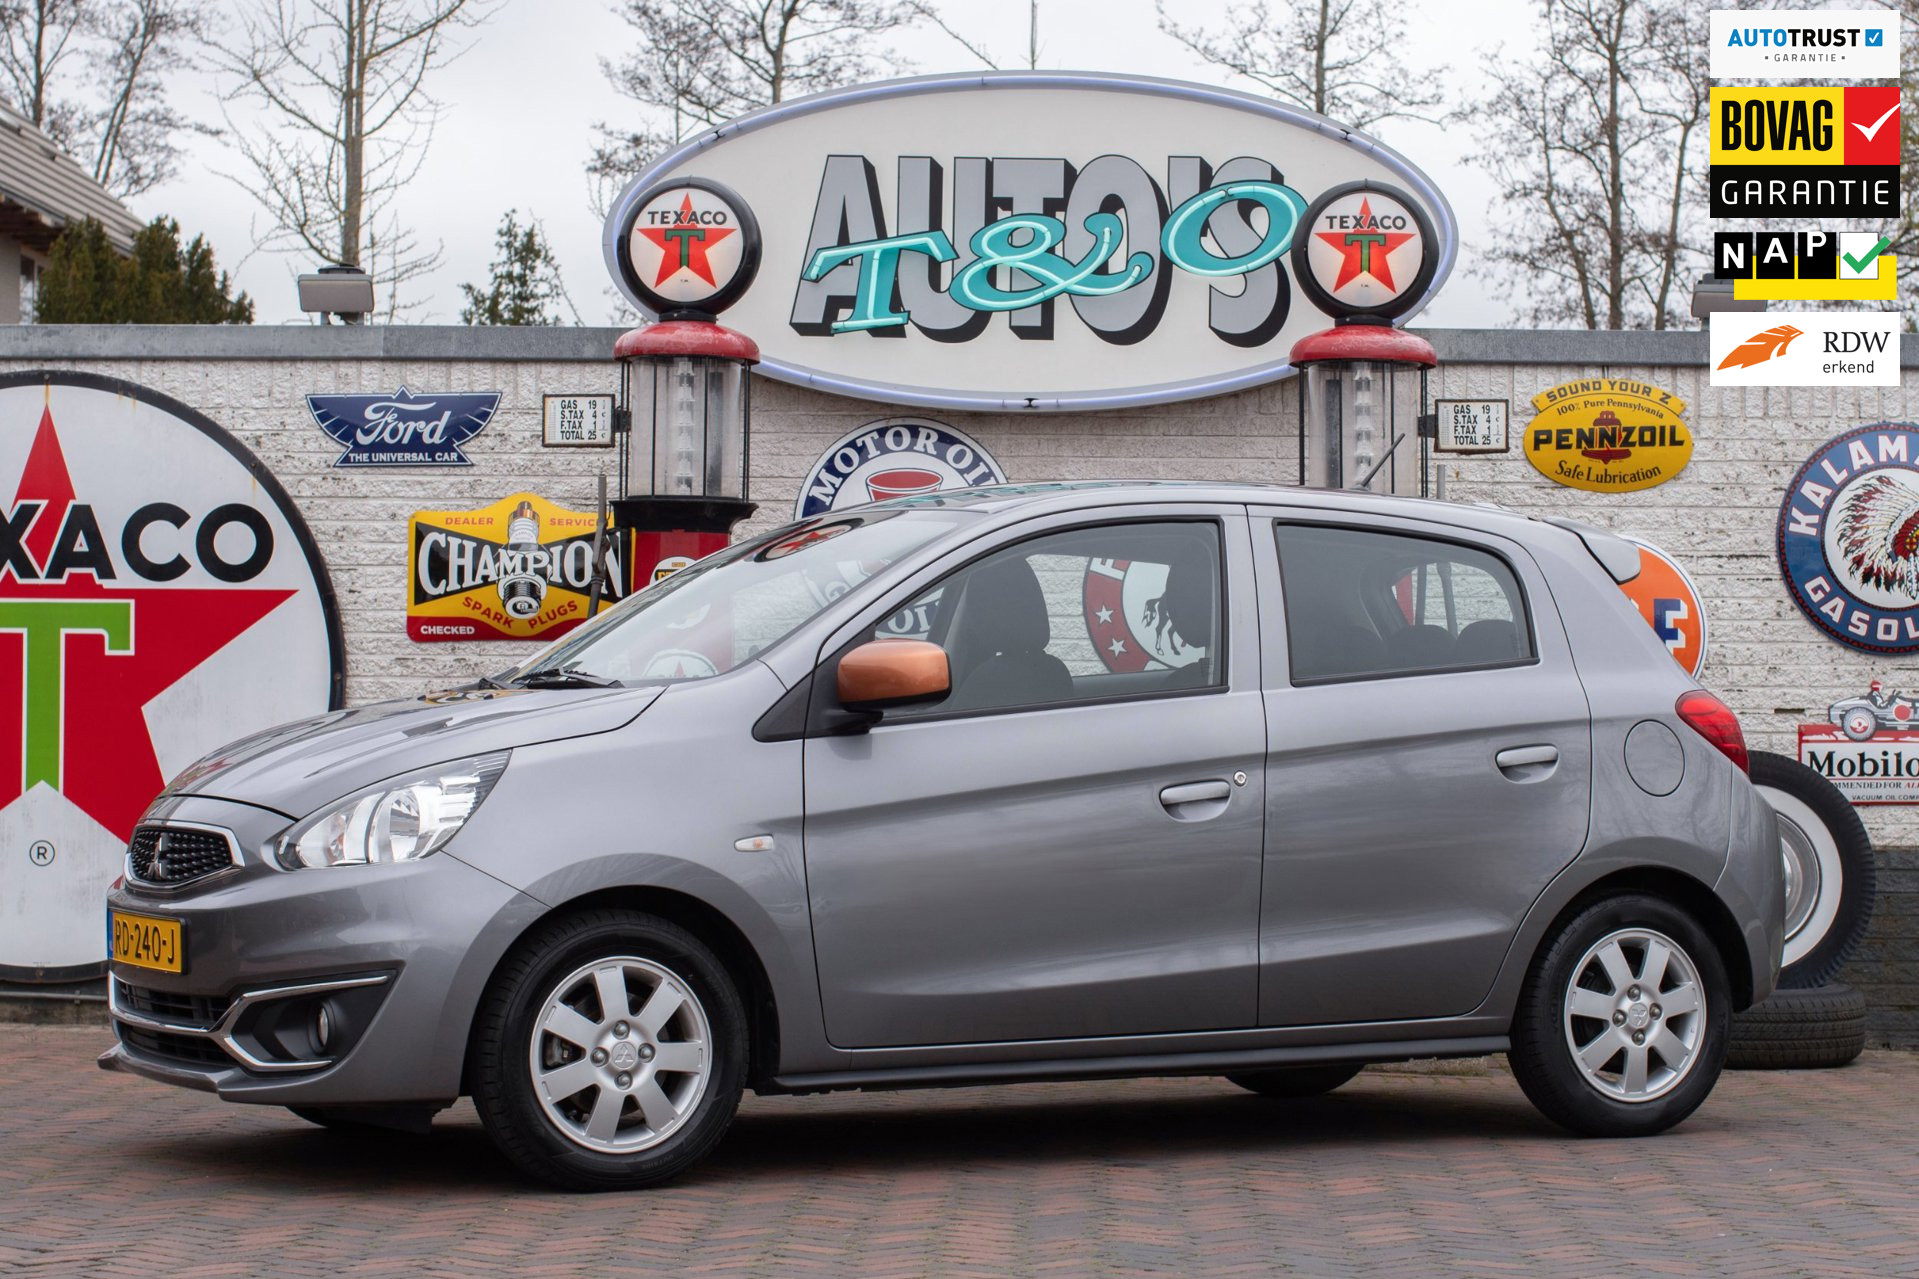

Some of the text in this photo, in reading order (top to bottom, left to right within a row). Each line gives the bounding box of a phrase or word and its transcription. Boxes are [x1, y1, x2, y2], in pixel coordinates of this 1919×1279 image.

[647, 210, 728, 226] TEXACO
[1325, 215, 1407, 230] TEXACO
[789, 154, 1291, 346] AUTO'S
[1547, 380, 1672, 405] SOUND YOUR Z
[560, 399, 578, 410] GAS
[588, 399, 597, 410] 19
[1453, 404, 1471, 415] GAS
[1481, 404, 1491, 415] 19
[1584, 400, 1605, 409] Pure
[1607, 399, 1665, 420] Pennsylvania
[560, 410, 585, 420] S.TAX
[592, 410, 597, 420] 4
[1453, 414, 1478, 425] S.TAX
[1486, 414, 1491, 425] 4
[355, 401, 452, 446] Ford
[560, 420, 583, 430] F.TAX
[593, 420, 597, 431] 1
[1453, 425, 1477, 435] F.TAX
[1487, 425, 1491, 435] 1
[560, 430, 585, 440] TOTAL
[588, 430, 597, 440] 25
[1453, 435, 1479, 446] TOTAL
[1481, 435, 1491, 446] 25
[1533, 424, 1686, 452] PENNZOIL
[348, 452, 458, 463] THE UNIVERSAL CAR
[808, 426, 998, 507] MOTOR OI
[1554, 459, 1662, 485] Safe Lubrication
[445, 517, 598, 527] DEALER SERVIC
[418, 531, 623, 599] CHAMPION
[462, 596, 578, 630] SPARK PLUGS
[420, 625, 475, 635] CHECKED
[1884, 781, 1902, 790] FOR
[115, 919, 175, 965] RD-240-J
